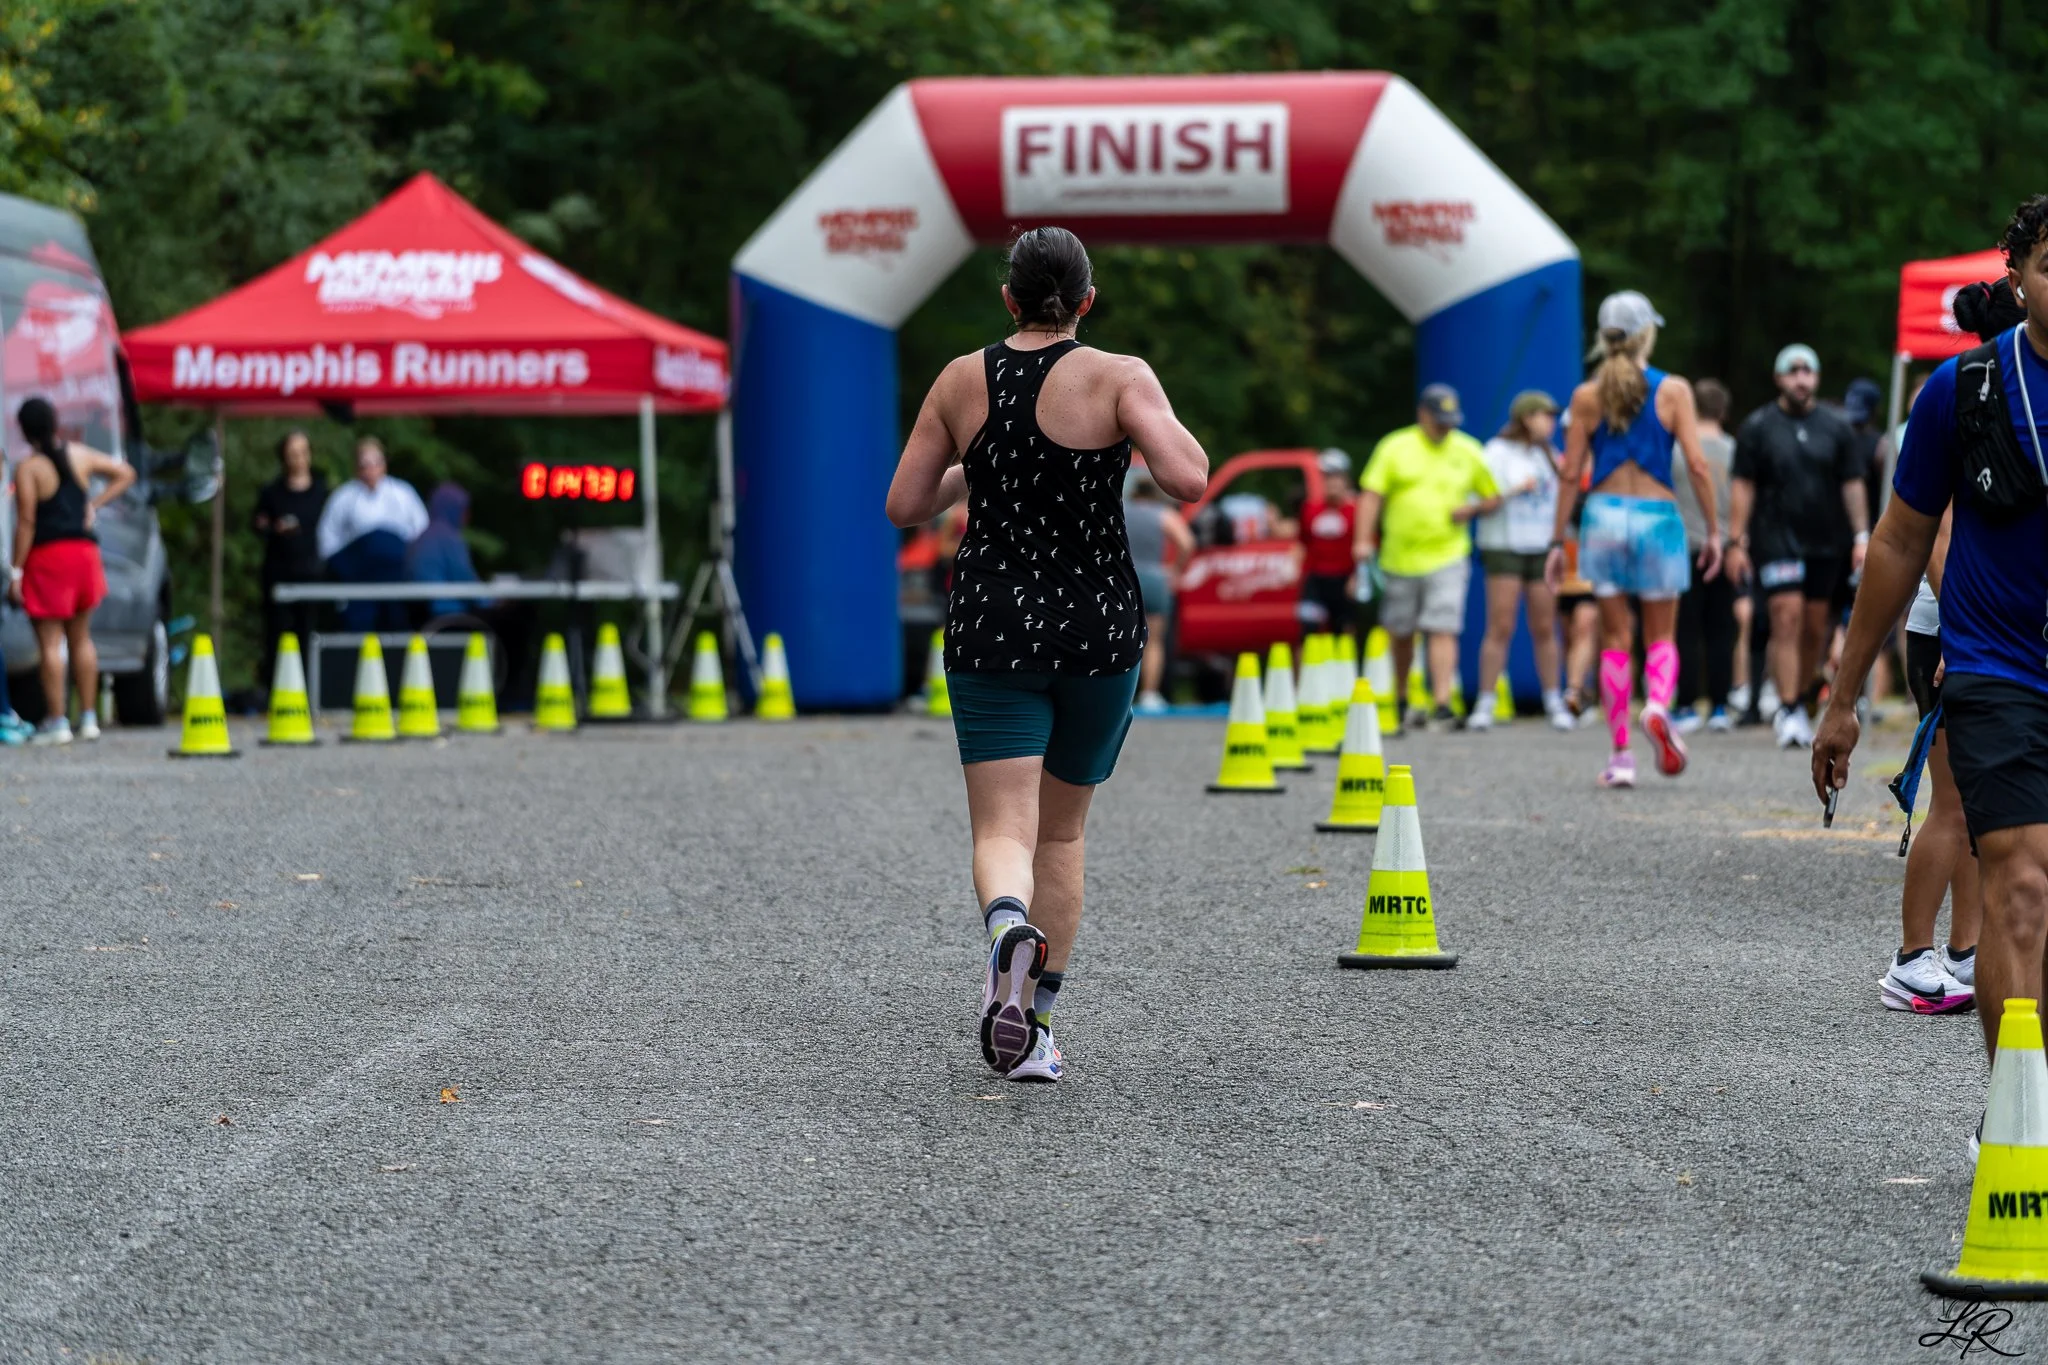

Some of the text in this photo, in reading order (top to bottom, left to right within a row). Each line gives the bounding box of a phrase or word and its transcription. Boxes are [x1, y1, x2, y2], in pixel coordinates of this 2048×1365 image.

[1016, 121, 1272, 176] FINISH
[174, 342, 588, 395] Memphis Runners
[1369, 895, 1427, 915] MRTC
